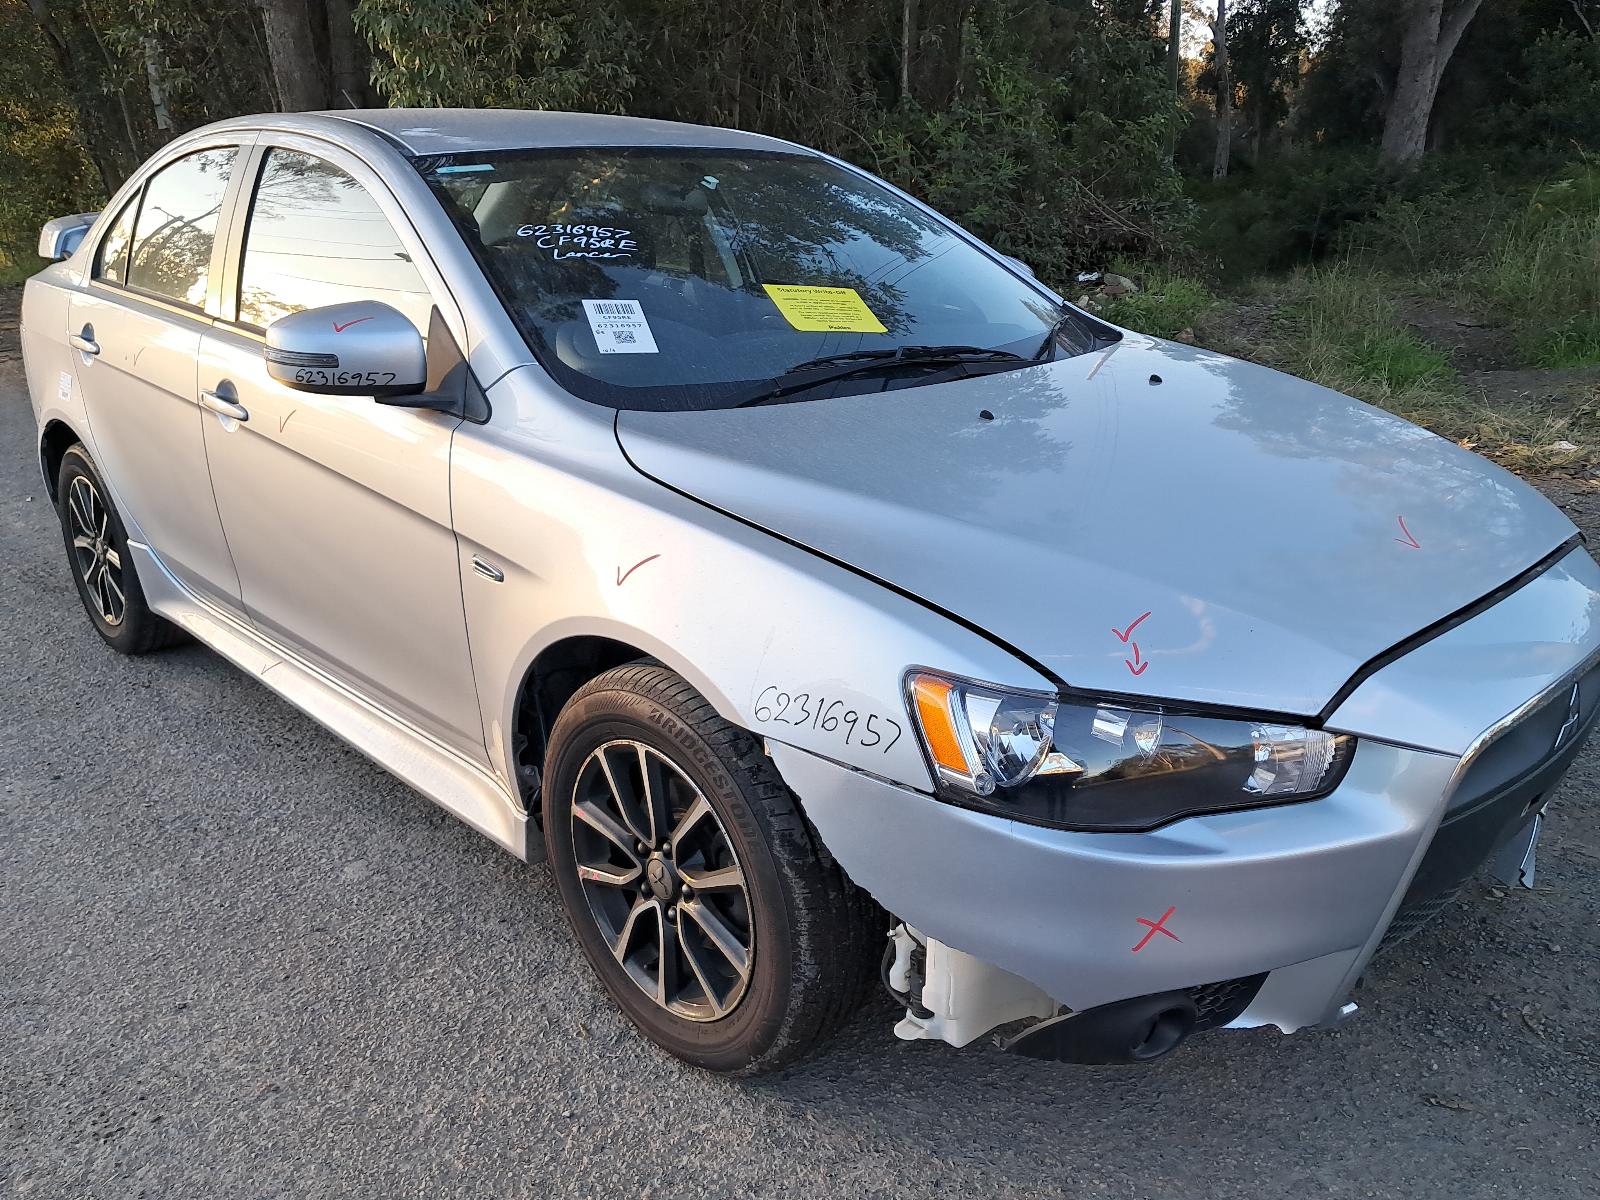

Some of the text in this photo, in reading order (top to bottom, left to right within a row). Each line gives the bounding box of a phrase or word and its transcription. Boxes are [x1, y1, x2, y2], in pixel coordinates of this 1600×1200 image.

[516, 224, 631, 238] 62316957
[295, 368, 397, 386] 62316957
[754, 685, 902, 754] 62316957
